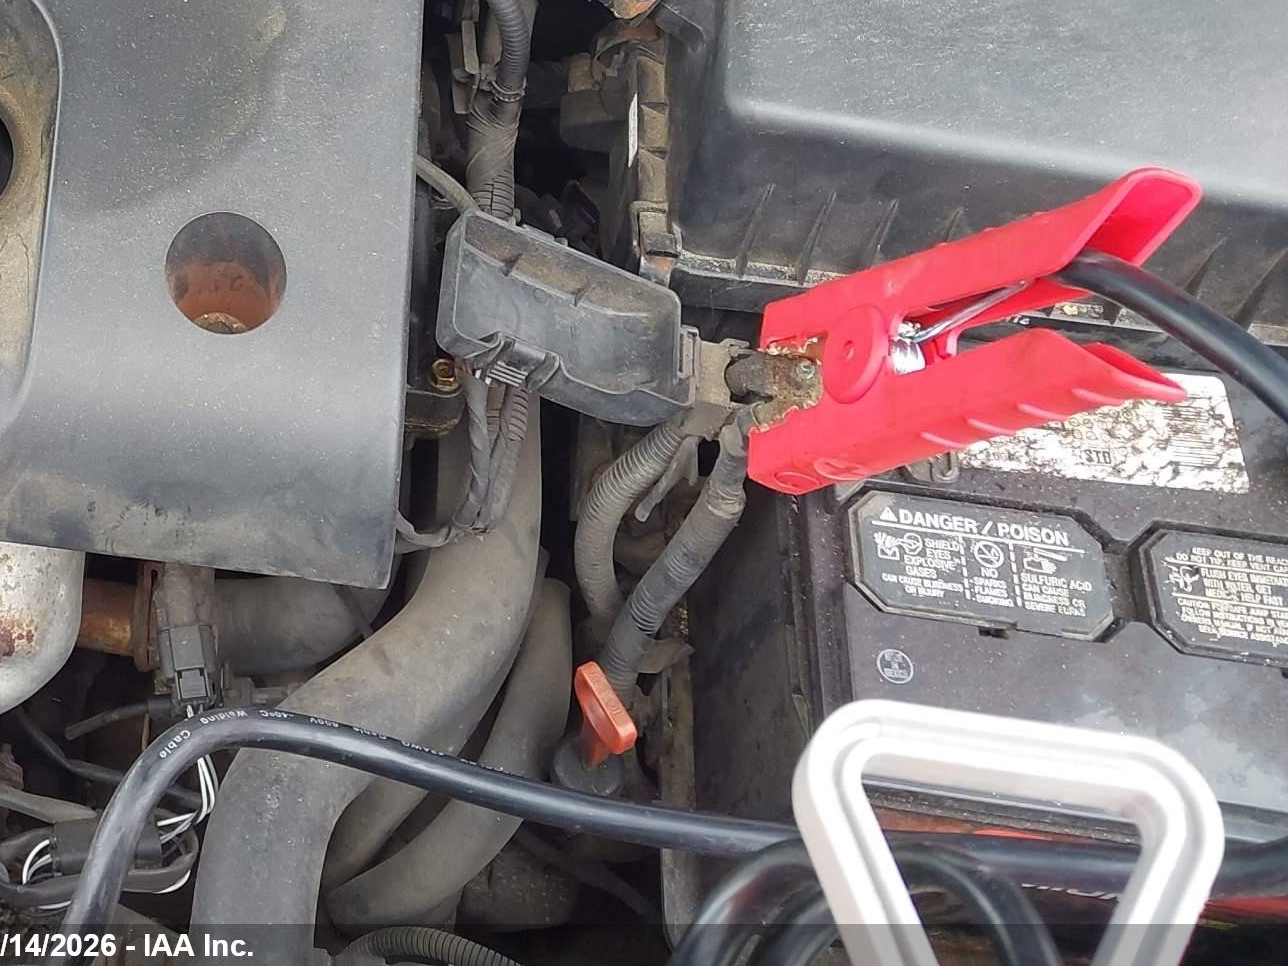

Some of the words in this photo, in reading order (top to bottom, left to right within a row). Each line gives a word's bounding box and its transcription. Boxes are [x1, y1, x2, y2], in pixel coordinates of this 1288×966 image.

[898, 509, 977, 534] DANGER
[997, 522, 1069, 547] POISON
[924, 537, 960, 552] SHIELD
[926, 548, 951, 560] EYES
[1175, 552, 1189, 561] DO
[1192, 546, 1212, 556] KEEP
[1214, 549, 1231, 558] OUT
[1248, 553, 1265, 563] THE
[904, 554, 956, 571] EXPLOSIVE
[905, 565, 937, 579] GASES
[980, 566, 999, 578] NO
[1200, 567, 1227, 579] FLUSH
[1228, 571, 1249, 582] EYES
[1020, 573, 1068, 588] SULFURIC
[1069, 579, 1092, 591] ACID
[1255, 584, 1272, 595] GET
[1021, 583, 1040, 593] CAN
[1042, 586, 1070, 597] CAUSE
[199, 709, 249, 725] Welding
[159, 729, 191, 760] Cable
